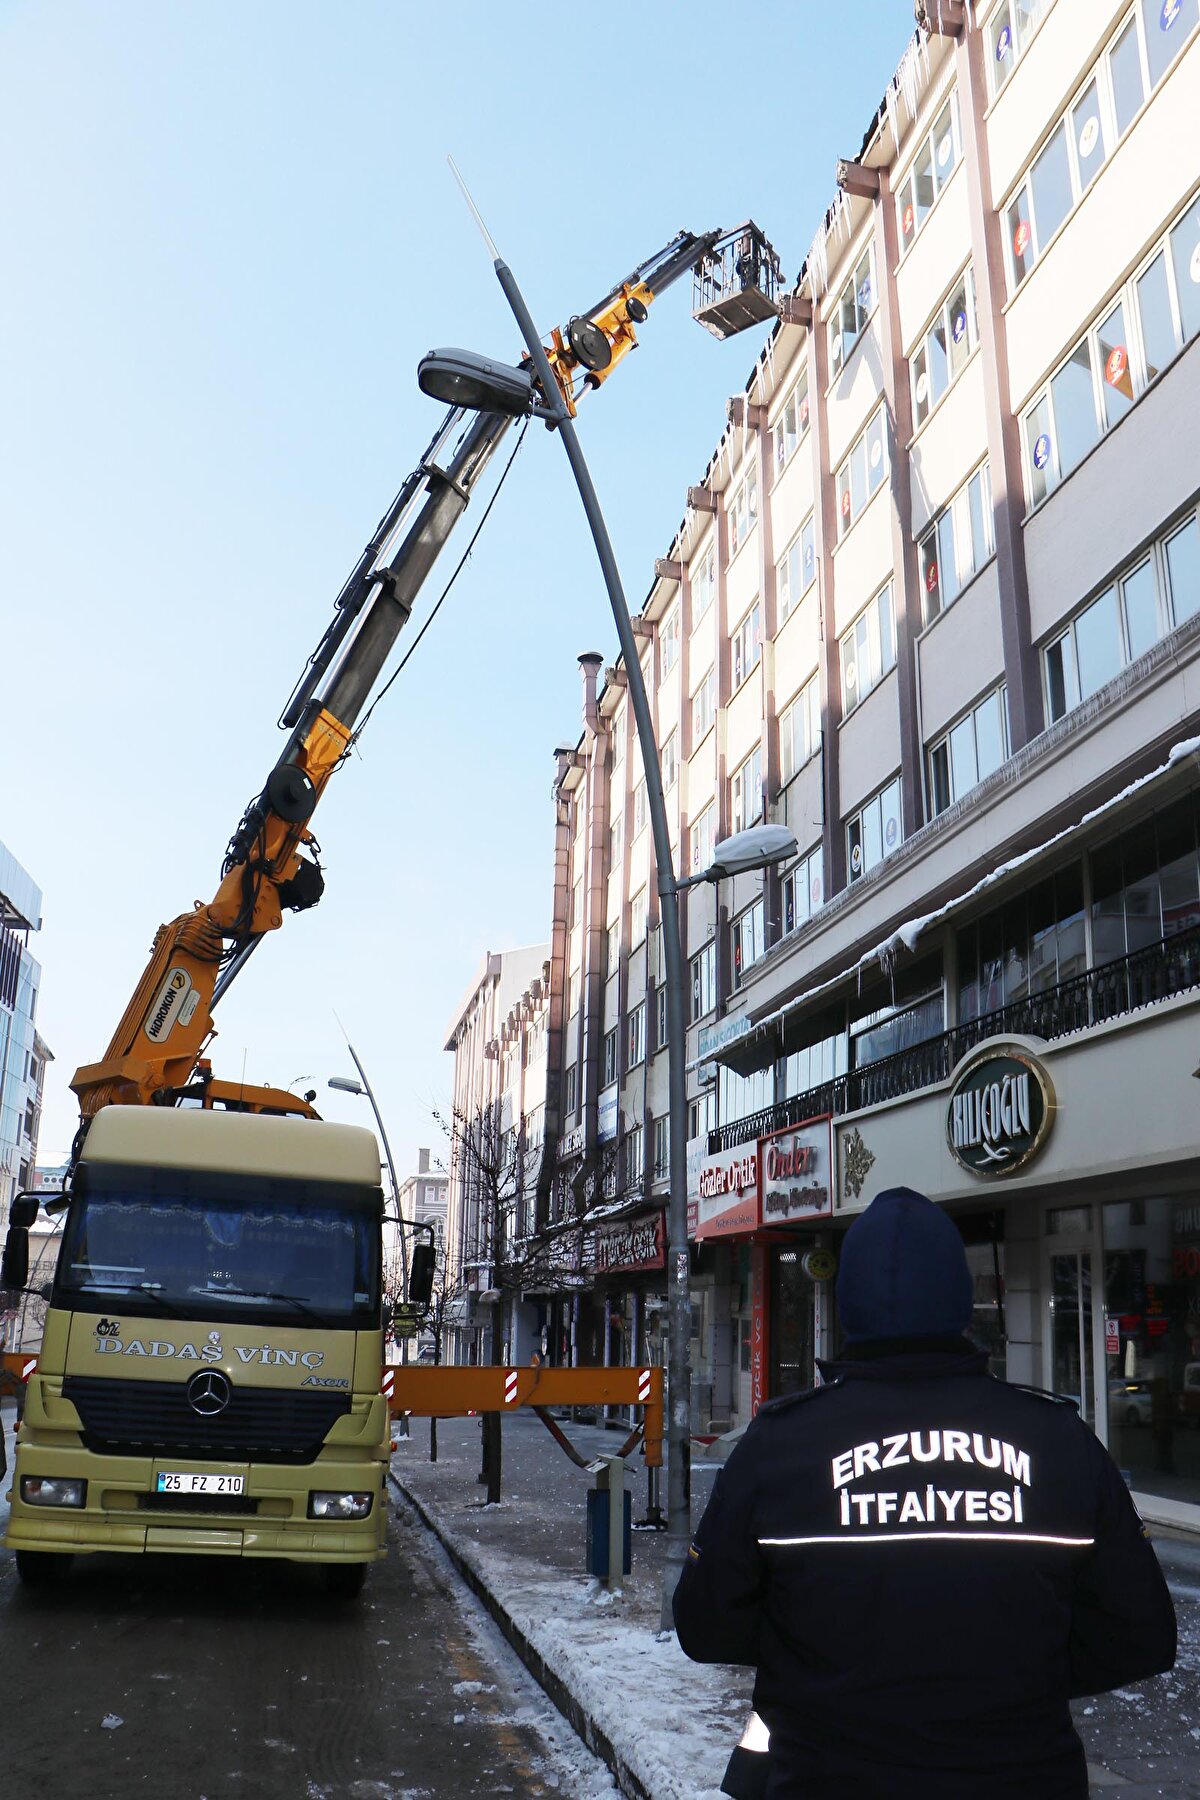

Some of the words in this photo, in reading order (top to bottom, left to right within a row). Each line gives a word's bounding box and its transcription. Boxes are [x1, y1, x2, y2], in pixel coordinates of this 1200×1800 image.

[953, 1072, 1031, 1164] KILIÇOĞLU
[728, 1155, 757, 1198] Optik
[95, 1337, 224, 1363] DADAŞ
[233, 1344, 325, 1369] VİNÇ
[832, 1430, 1032, 1490] ERZURUM
[165, 1475, 181, 1490] 25
[191, 1476, 208, 1491] FZ
[217, 1477, 241, 1492] 210
[840, 1484, 1024, 1526] İTFAİYESİ
